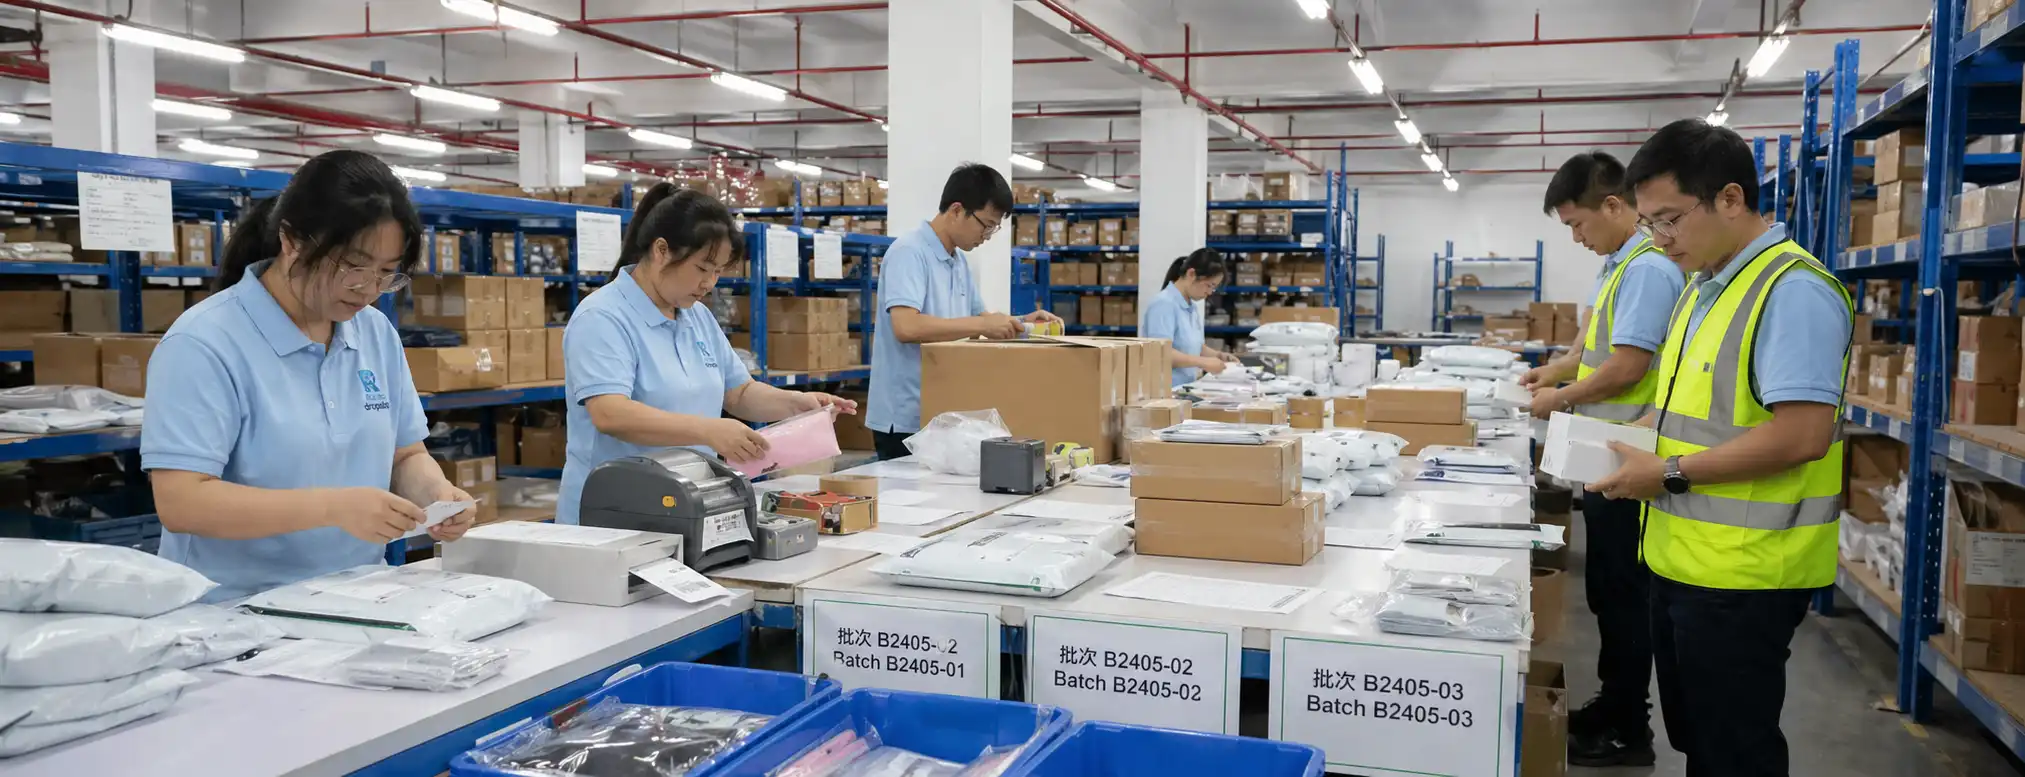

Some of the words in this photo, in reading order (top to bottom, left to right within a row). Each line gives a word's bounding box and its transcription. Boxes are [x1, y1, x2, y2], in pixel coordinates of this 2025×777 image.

[838, 627, 872, 648] 批次
[887, 656, 964, 679] B2405-01
[1060, 644, 1097, 667] 批次
[1105, 651, 1193, 676] B2405-02
[1055, 670, 1106, 691] Batch
[1114, 676, 1201, 702] B2405-02
[1313, 668, 1356, 692] 批次
[1364, 674, 1464, 701] B2405-03
[1307, 694, 1366, 717] Batch
[1374, 701, 1473, 728] B2405-03
